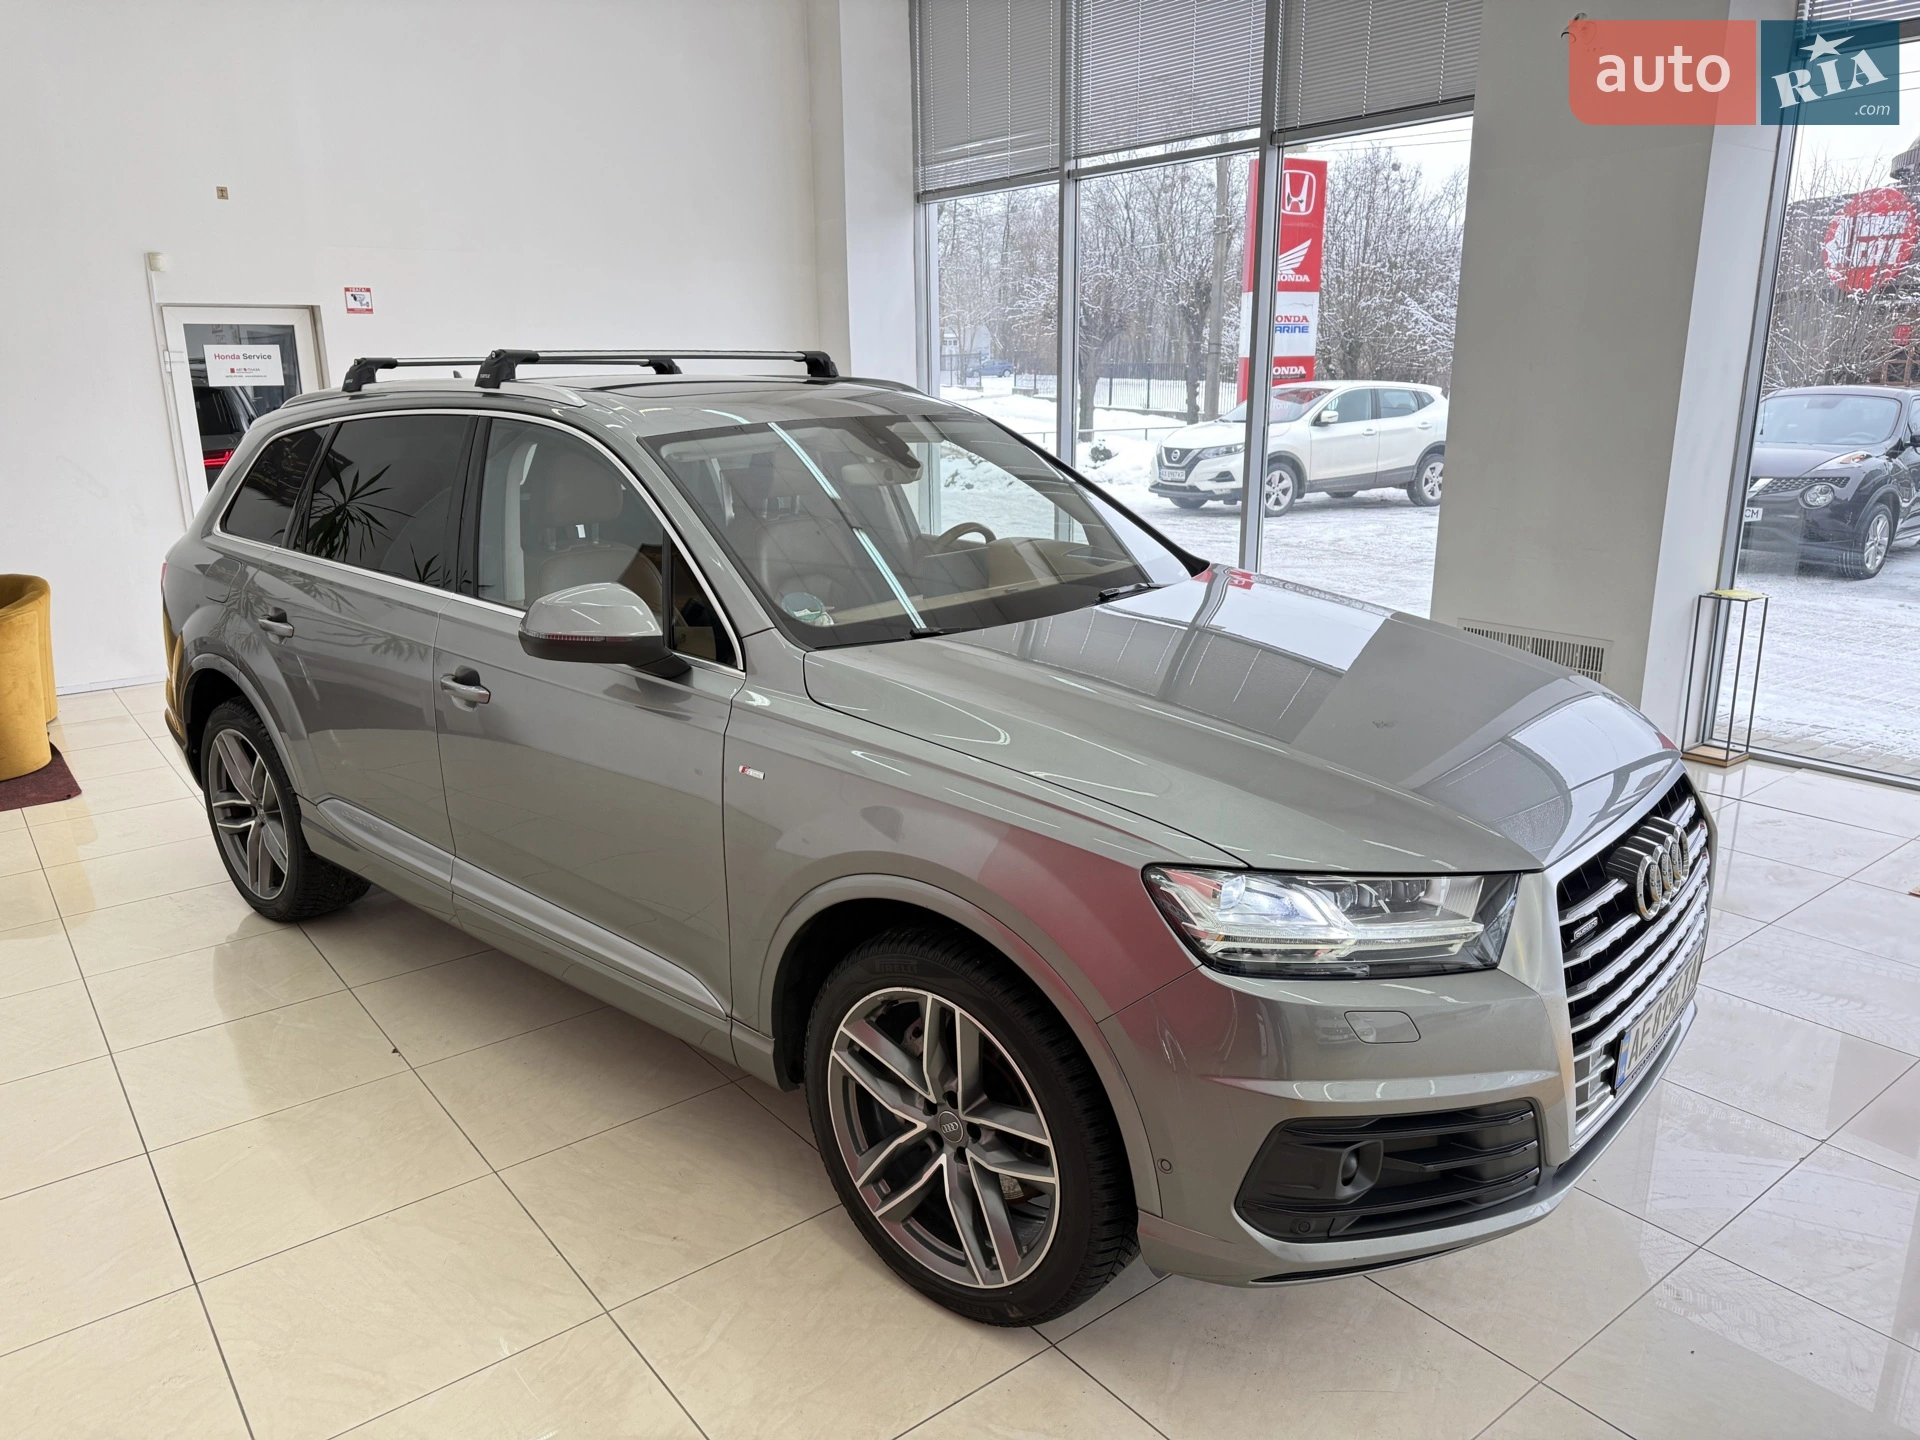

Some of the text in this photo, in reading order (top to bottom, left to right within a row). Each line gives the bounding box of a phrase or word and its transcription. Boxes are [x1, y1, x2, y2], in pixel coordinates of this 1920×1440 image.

[1275, 315, 1309, 323] ONDA
[1275, 325, 1309, 334] ARINE
[1273, 366, 1306, 375] ONDA
[1627, 1013, 1653, 1071] AE
[1651, 975, 1682, 1040] 8156
[1680, 954, 1699, 1000] TA
